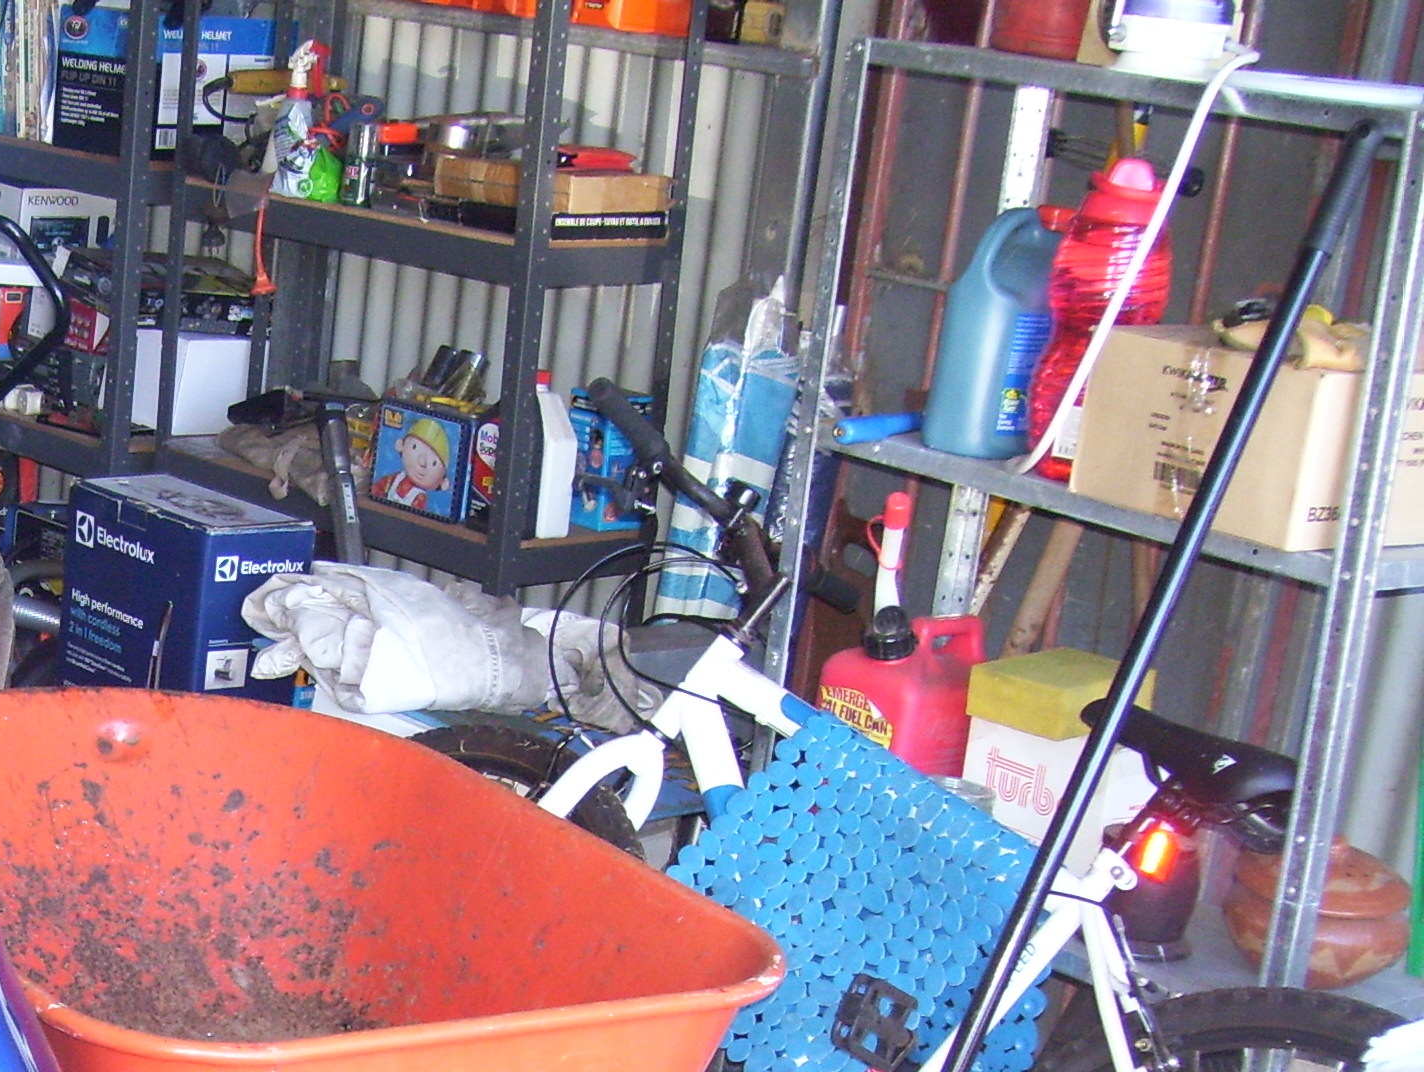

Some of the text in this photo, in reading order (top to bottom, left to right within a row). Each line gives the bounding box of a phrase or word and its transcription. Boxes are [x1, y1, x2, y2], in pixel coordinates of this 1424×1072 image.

[201, 31, 232, 41] HELMET
[62, 57, 125, 74] WELDING HELME
[27, 195, 79, 206] KENWOOD
[96, 528, 155, 565] Electrolux
[240, 560, 304, 576] Electrolux
[71, 588, 144, 630] High performance
[68, 620, 75, 633] 2
[88, 628, 123, 654] freedom
[838, 704, 863, 727] FUEL
[864, 714, 889, 736] CAN
